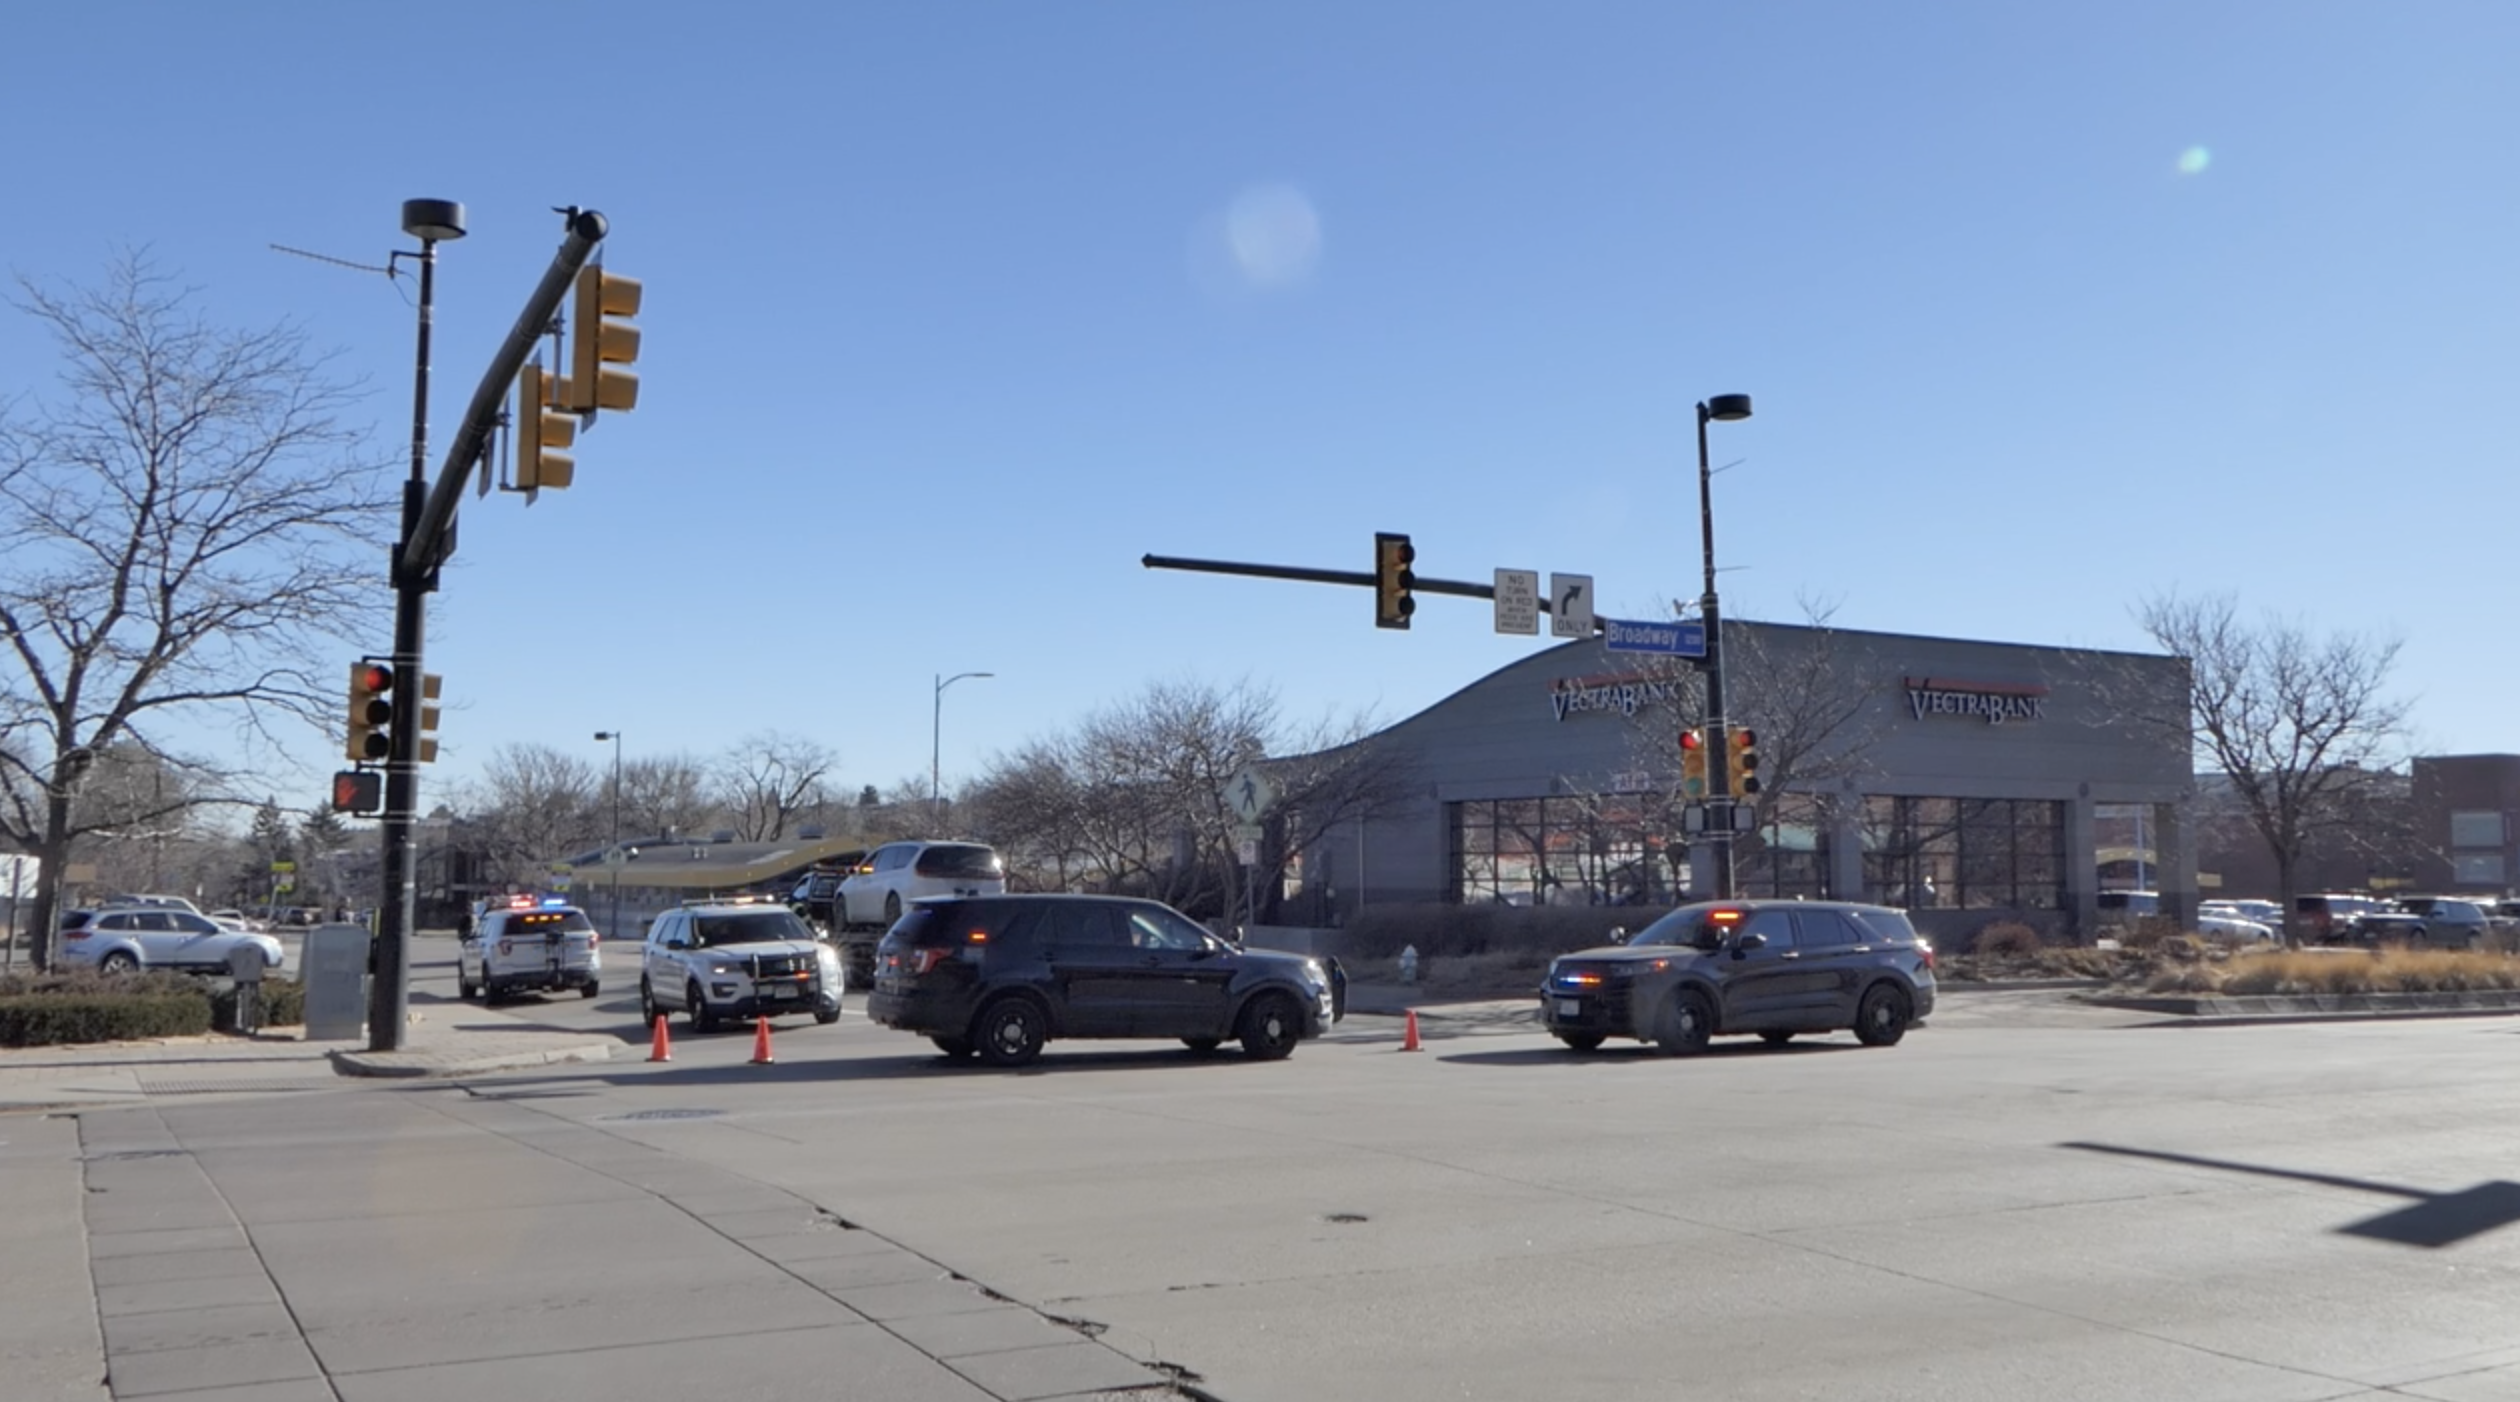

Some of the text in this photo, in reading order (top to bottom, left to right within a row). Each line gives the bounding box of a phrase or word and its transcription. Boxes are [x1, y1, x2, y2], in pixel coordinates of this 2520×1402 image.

[1507, 575, 1525, 585] NO
[1557, 619, 1588, 633] ONLY
[1609, 622, 1679, 651] Broadway
